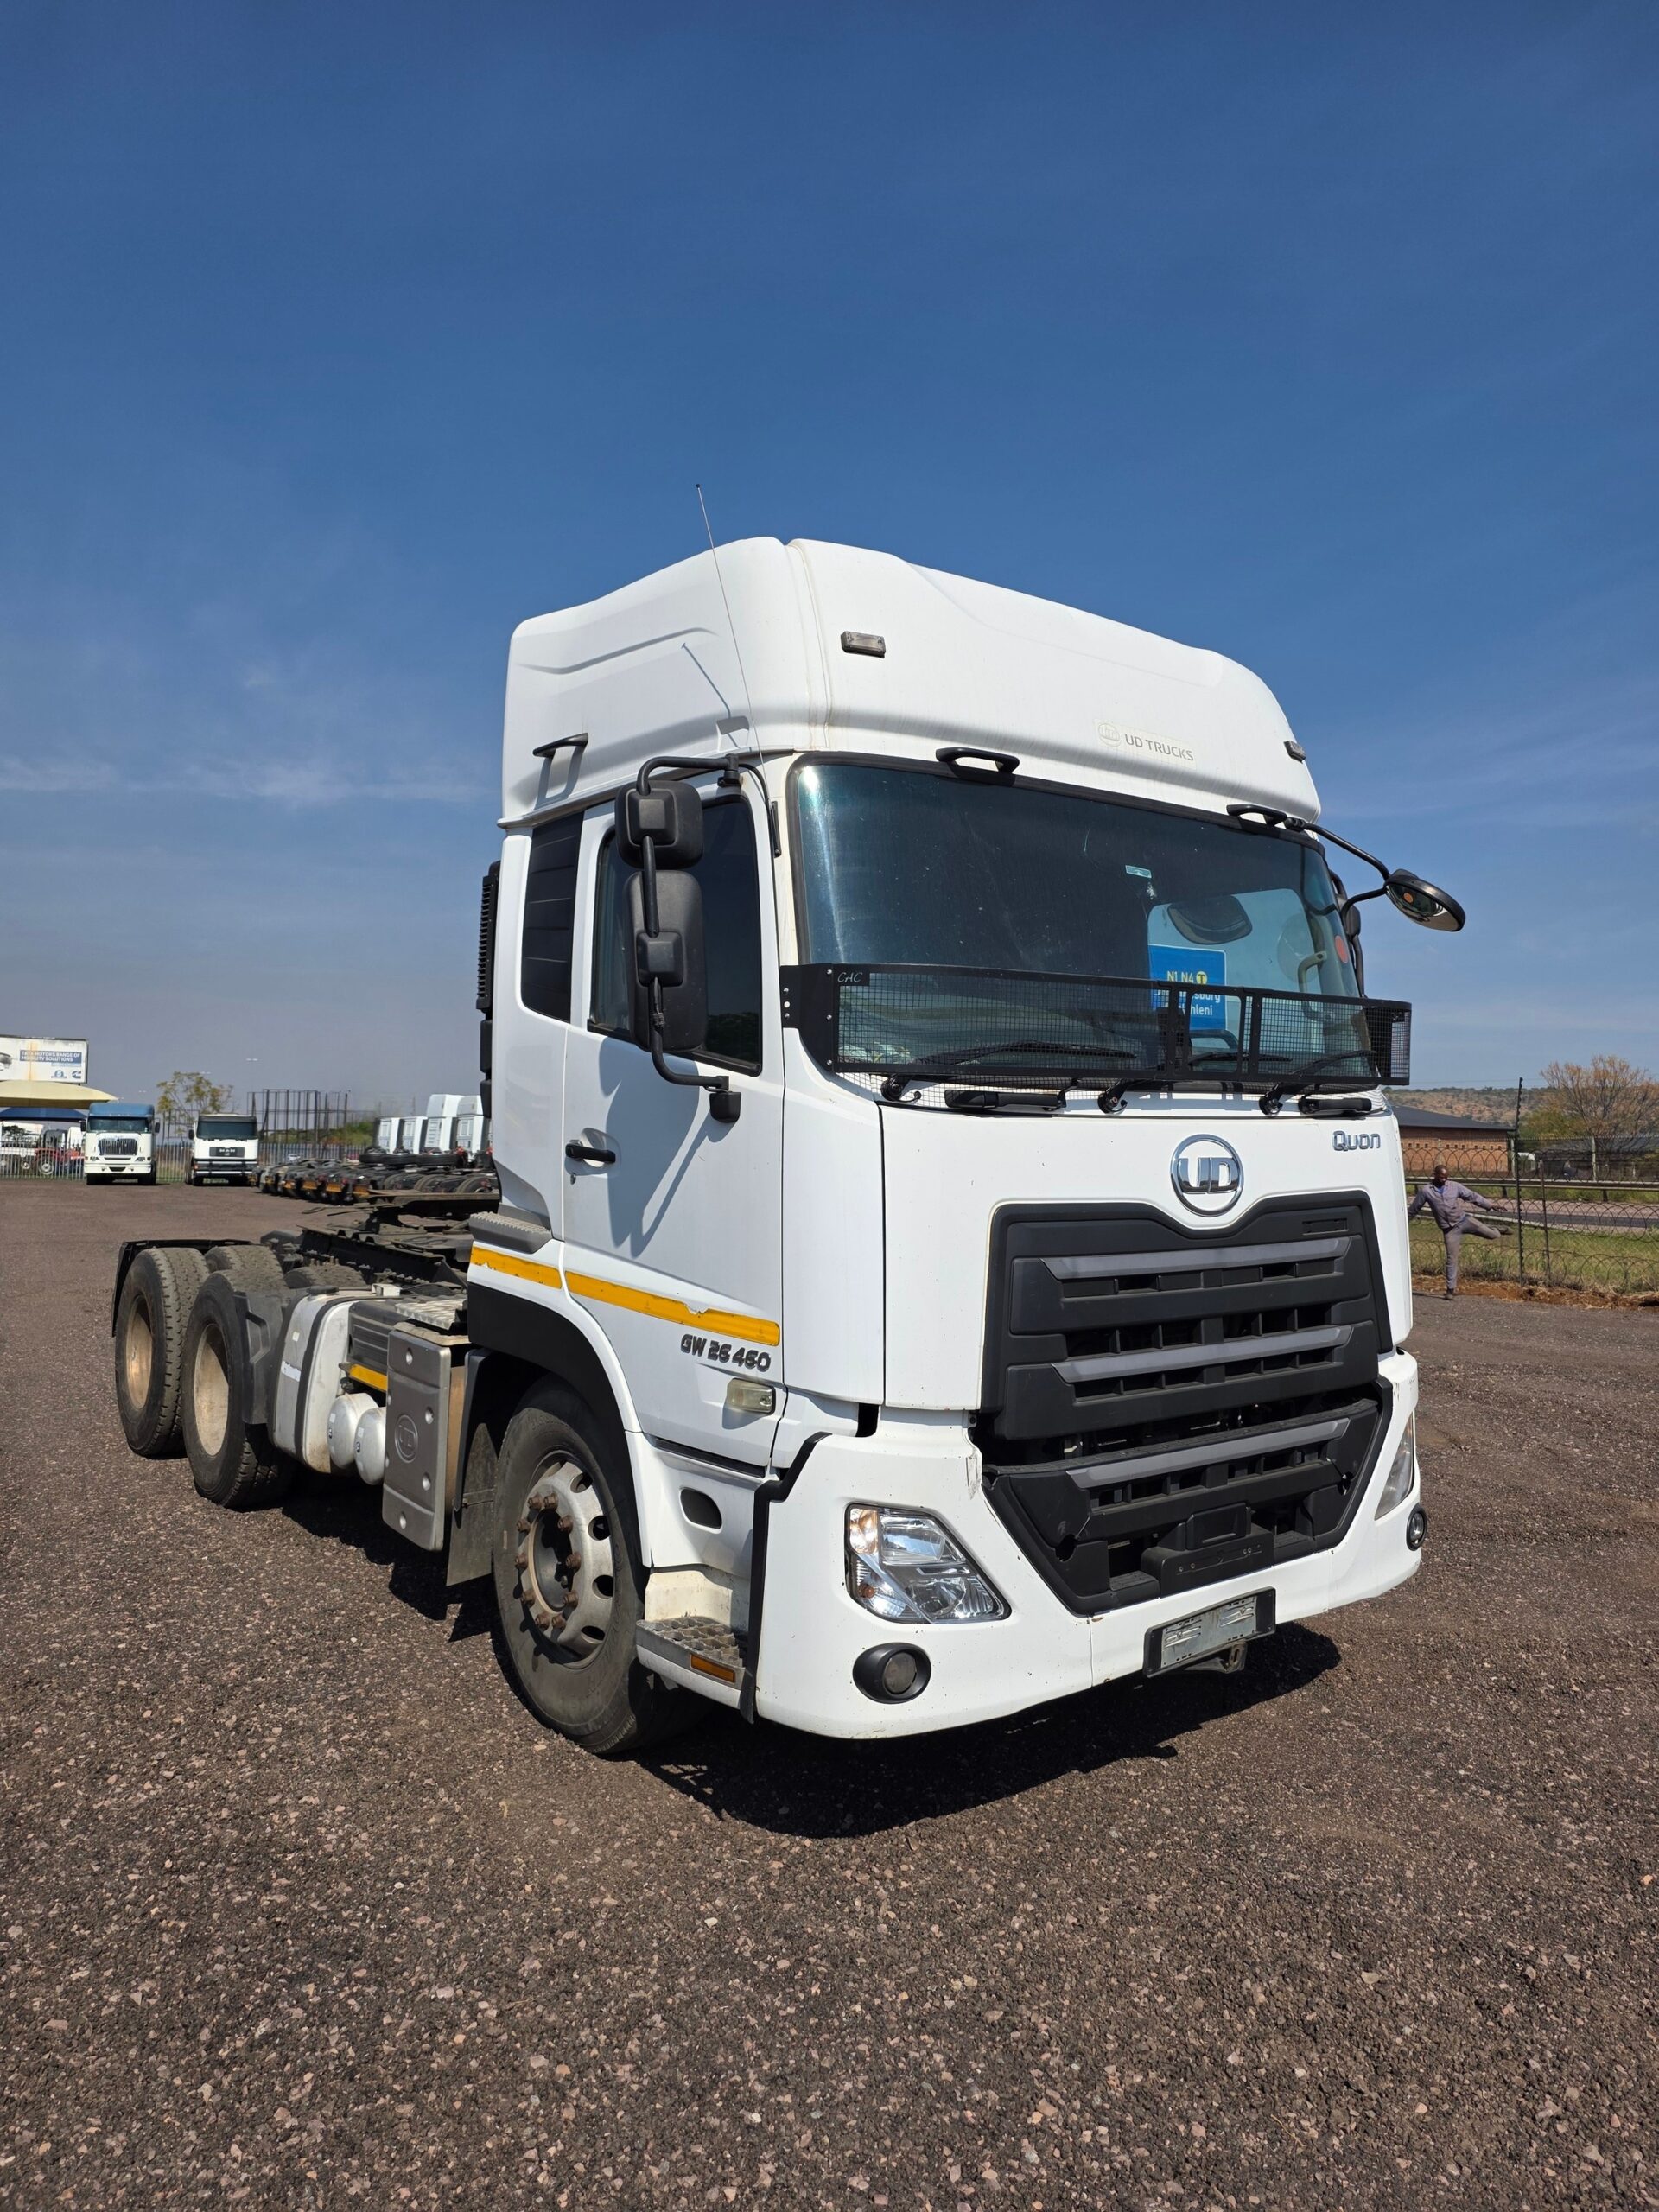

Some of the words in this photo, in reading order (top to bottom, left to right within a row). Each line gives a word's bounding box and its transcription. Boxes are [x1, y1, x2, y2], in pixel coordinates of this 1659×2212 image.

[1124, 734, 1143, 747] UD
[1145, 739, 1194, 761] TRUCKS
[1167, 970, 1178, 982] N1
[1181, 971, 1194, 983] N4
[1332, 1130, 1381, 1152] Quon
[1177, 1157, 1238, 1194] UD
[680, 1333, 707, 1357] GW
[707, 1339, 732, 1363] 26
[732, 1347, 772, 1372] 460
